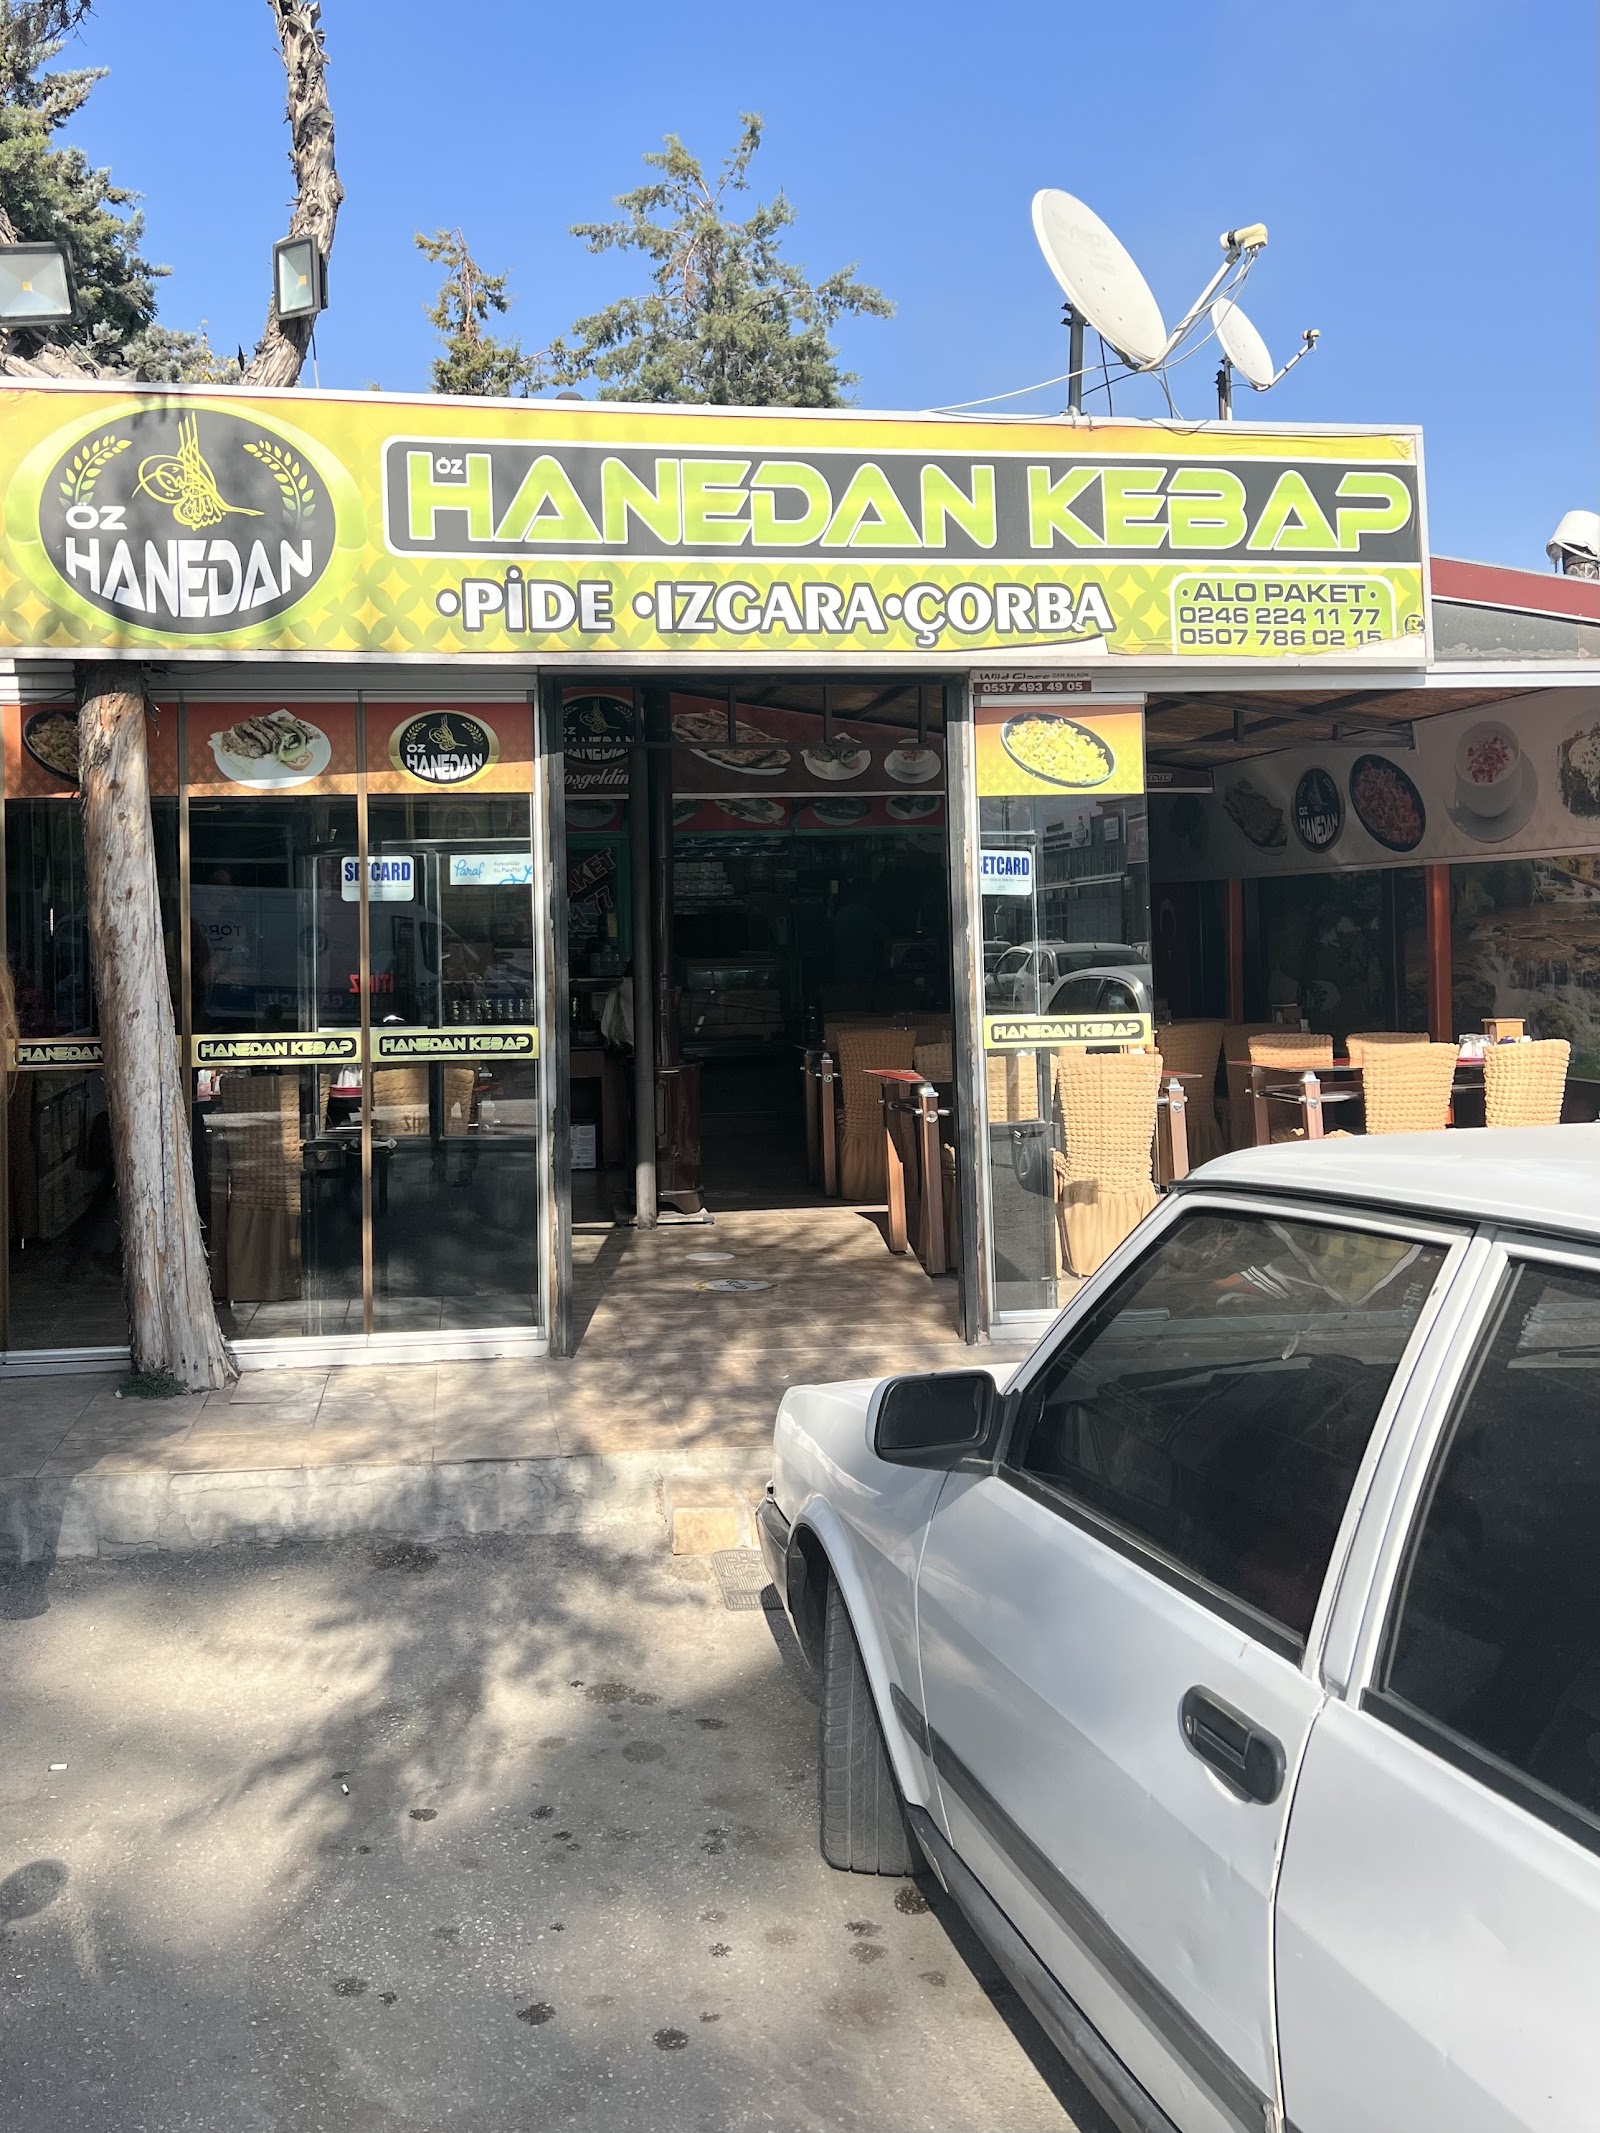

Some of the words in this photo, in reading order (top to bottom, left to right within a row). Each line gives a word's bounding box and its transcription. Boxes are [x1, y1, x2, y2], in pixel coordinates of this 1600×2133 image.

[436, 457, 464, 475] ÖZ
[406, 450, 997, 549] HANEDAN
[1027, 465, 1412, 552] KEBAP
[65, 502, 128, 530] ÖZ
[65, 536, 313, 618] HANEDAN
[1193, 582, 1257, 602] ALO
[1264, 583, 1366, 603] PAKET
[462, 565, 615, 633] PİDE
[655, 580, 889, 634] IZGARA
[901, 582, 1116, 647] ÇORBA
[1179, 606, 1249, 624] 0246
[1255, 607, 1306, 625] 224
[1313, 608, 1340, 625] 11
[1349, 609, 1380, 625] 77
[1179, 628, 1249, 645] 0507
[1259, 629, 1306, 646] 786
[1312, 629, 1345, 646] 02
[1353, 630, 1382, 645] 15
[982, 683, 1015, 693] 0537
[1019, 682, 1043, 692] 493
[1046, 682, 1063, 691] 49
[1066, 681, 1083, 691] 05
[406, 753, 483, 780] HANEDAN
[564, 768, 629, 790] oşgeldin
[1299, 812, 1338, 845] HANEDAN
[344, 862, 412, 882] SECARD
[454, 859, 485, 879] Paraf
[994, 1023, 1077, 1040] HANEDAN
[1080, 1022, 1141, 1037] KEBAP
[201, 1041, 288, 1057] HANEDAN
[290, 1040, 353, 1055] KEBAP
[382, 1036, 467, 1053] HANEDAN
[469, 1036, 529, 1051] KEBAP
